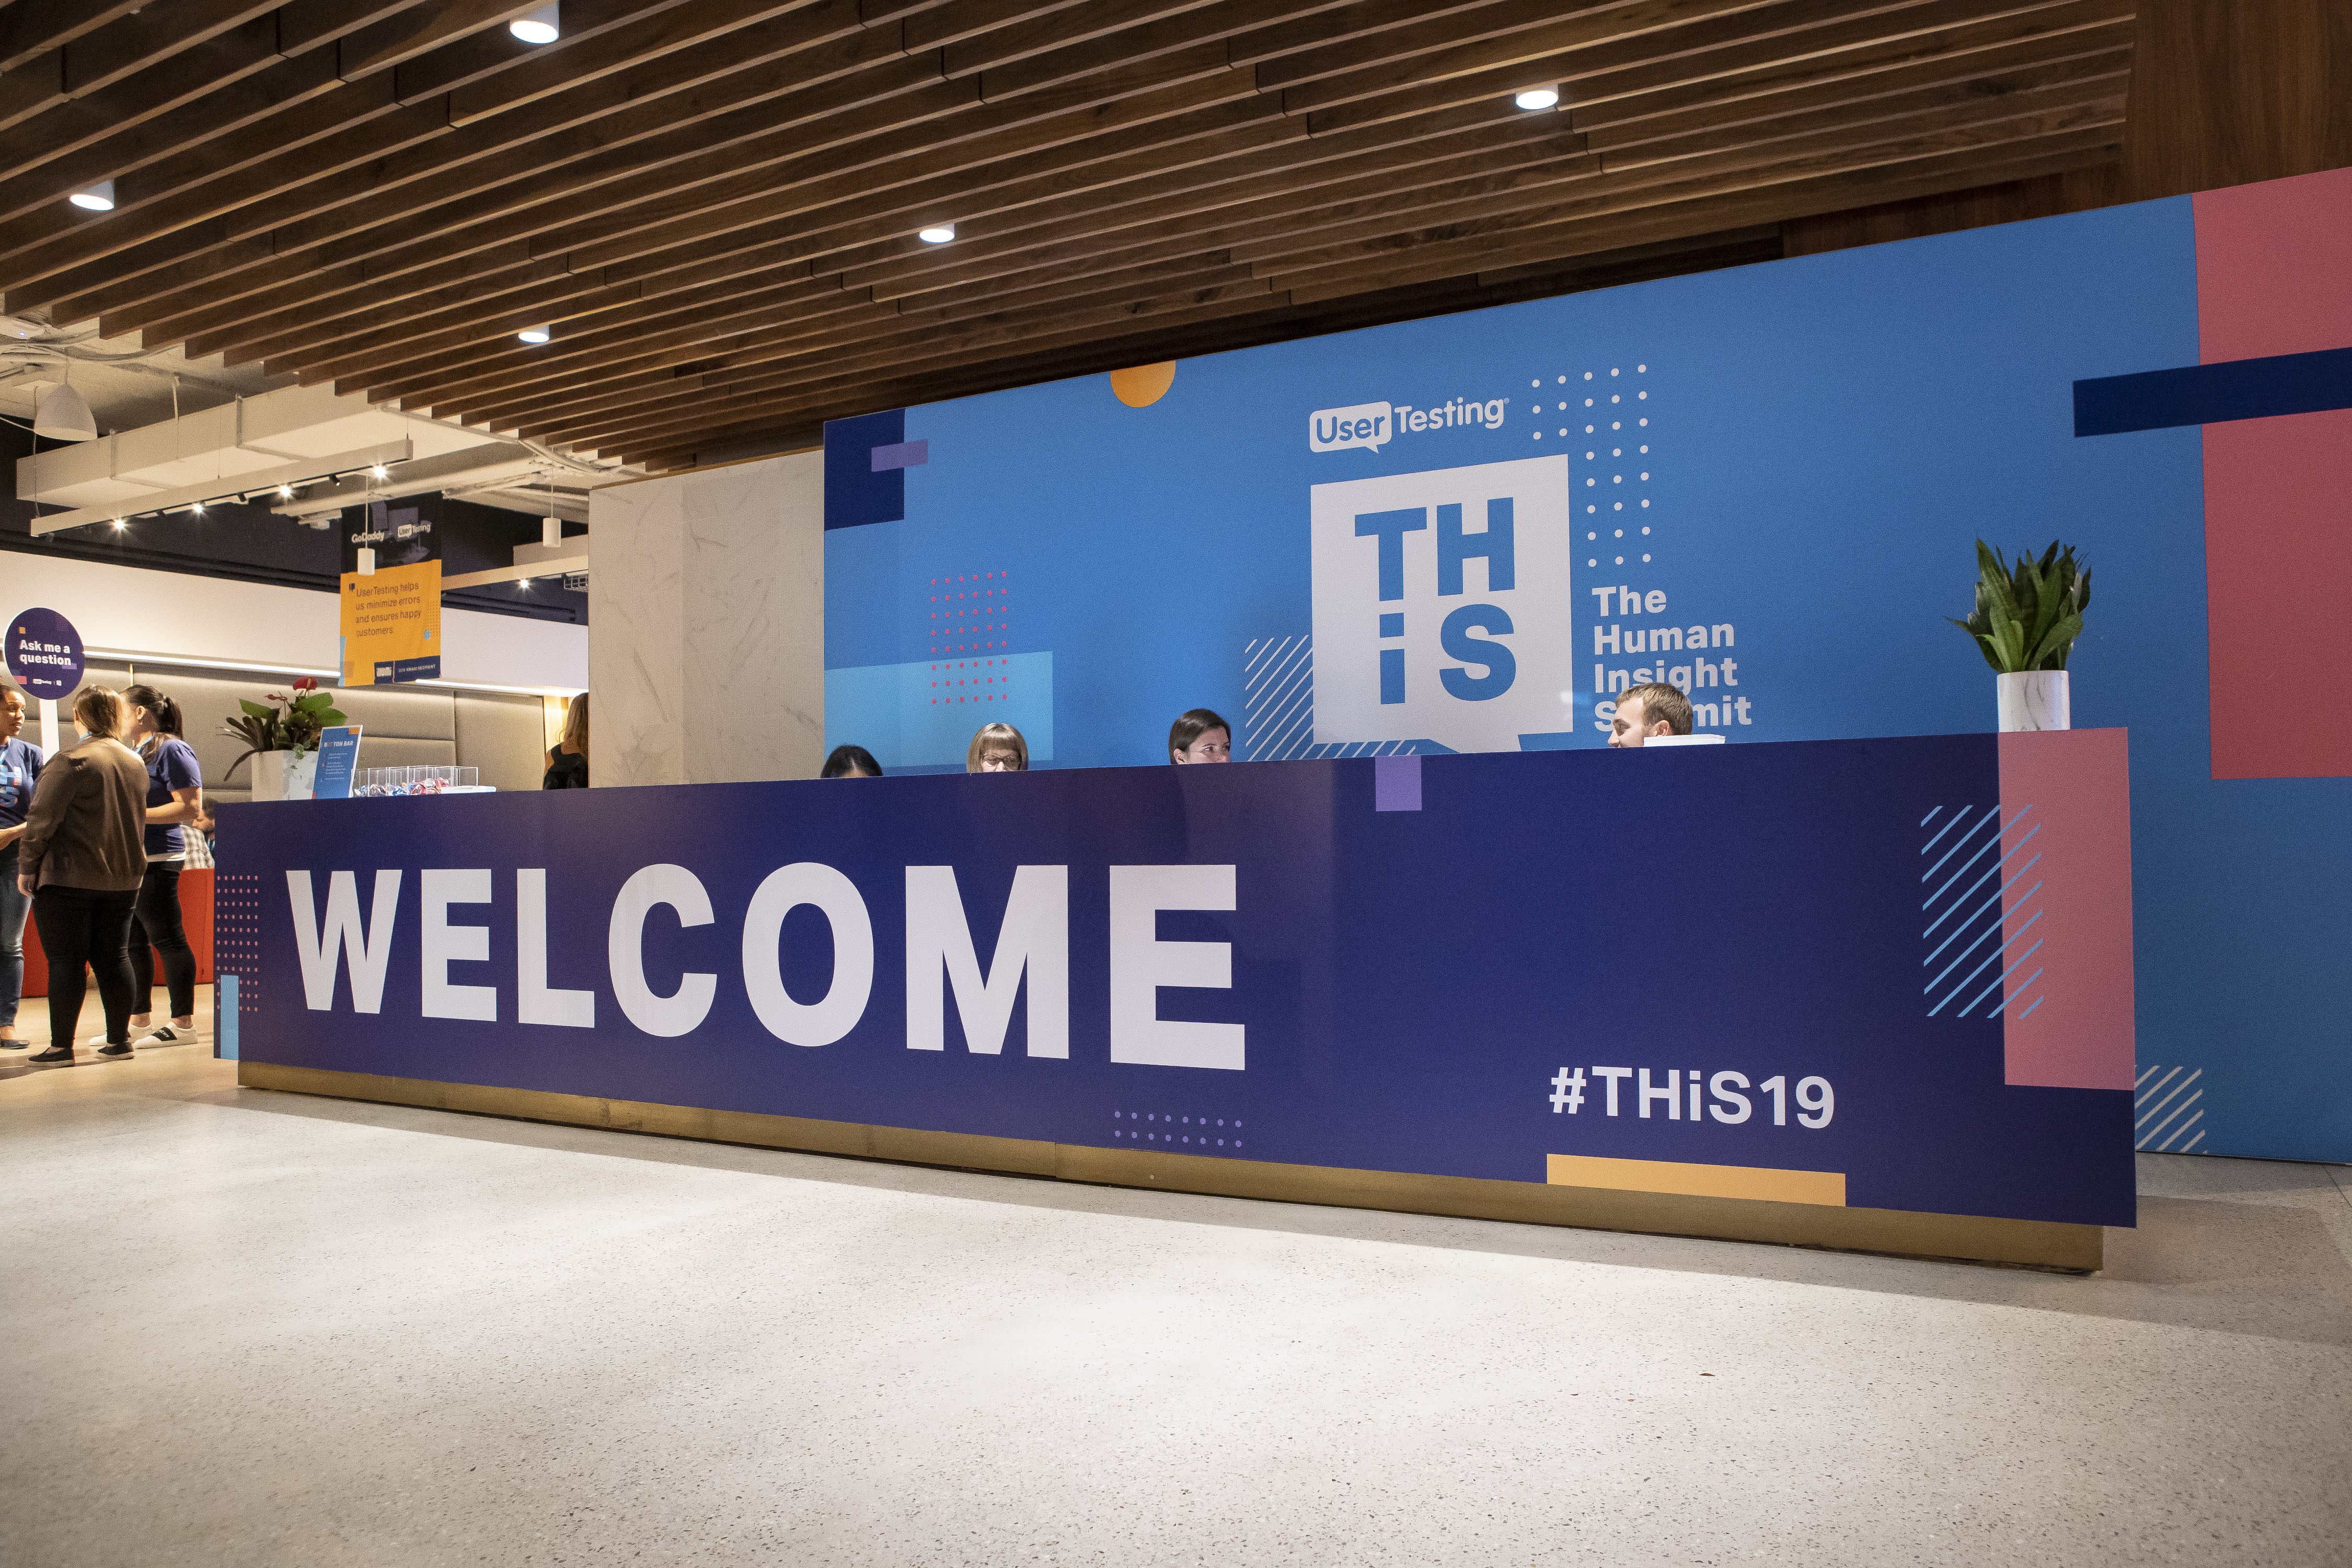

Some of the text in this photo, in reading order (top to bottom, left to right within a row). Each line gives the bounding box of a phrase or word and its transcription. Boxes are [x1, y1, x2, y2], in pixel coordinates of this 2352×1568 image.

[351, 531, 385, 543] GoDaddy
[356, 582, 419, 597] UserTesting helps
[366, 599, 397, 609] minimize
[399, 596, 420, 605] errors
[1592, 585, 1667, 617] The
[355, 610, 421, 624] and ensures happy
[356, 627, 394, 637] customers.
[1594, 623, 1735, 655] Human
[20, 639, 70, 653] Ask me a
[20, 654, 72, 666] question
[1595, 657, 1738, 696] Insight
[1594, 695, 1752, 732] Smit
[285, 862, 1246, 1070] WELCOME
[1549, 1066, 1835, 1128] #THiS19
